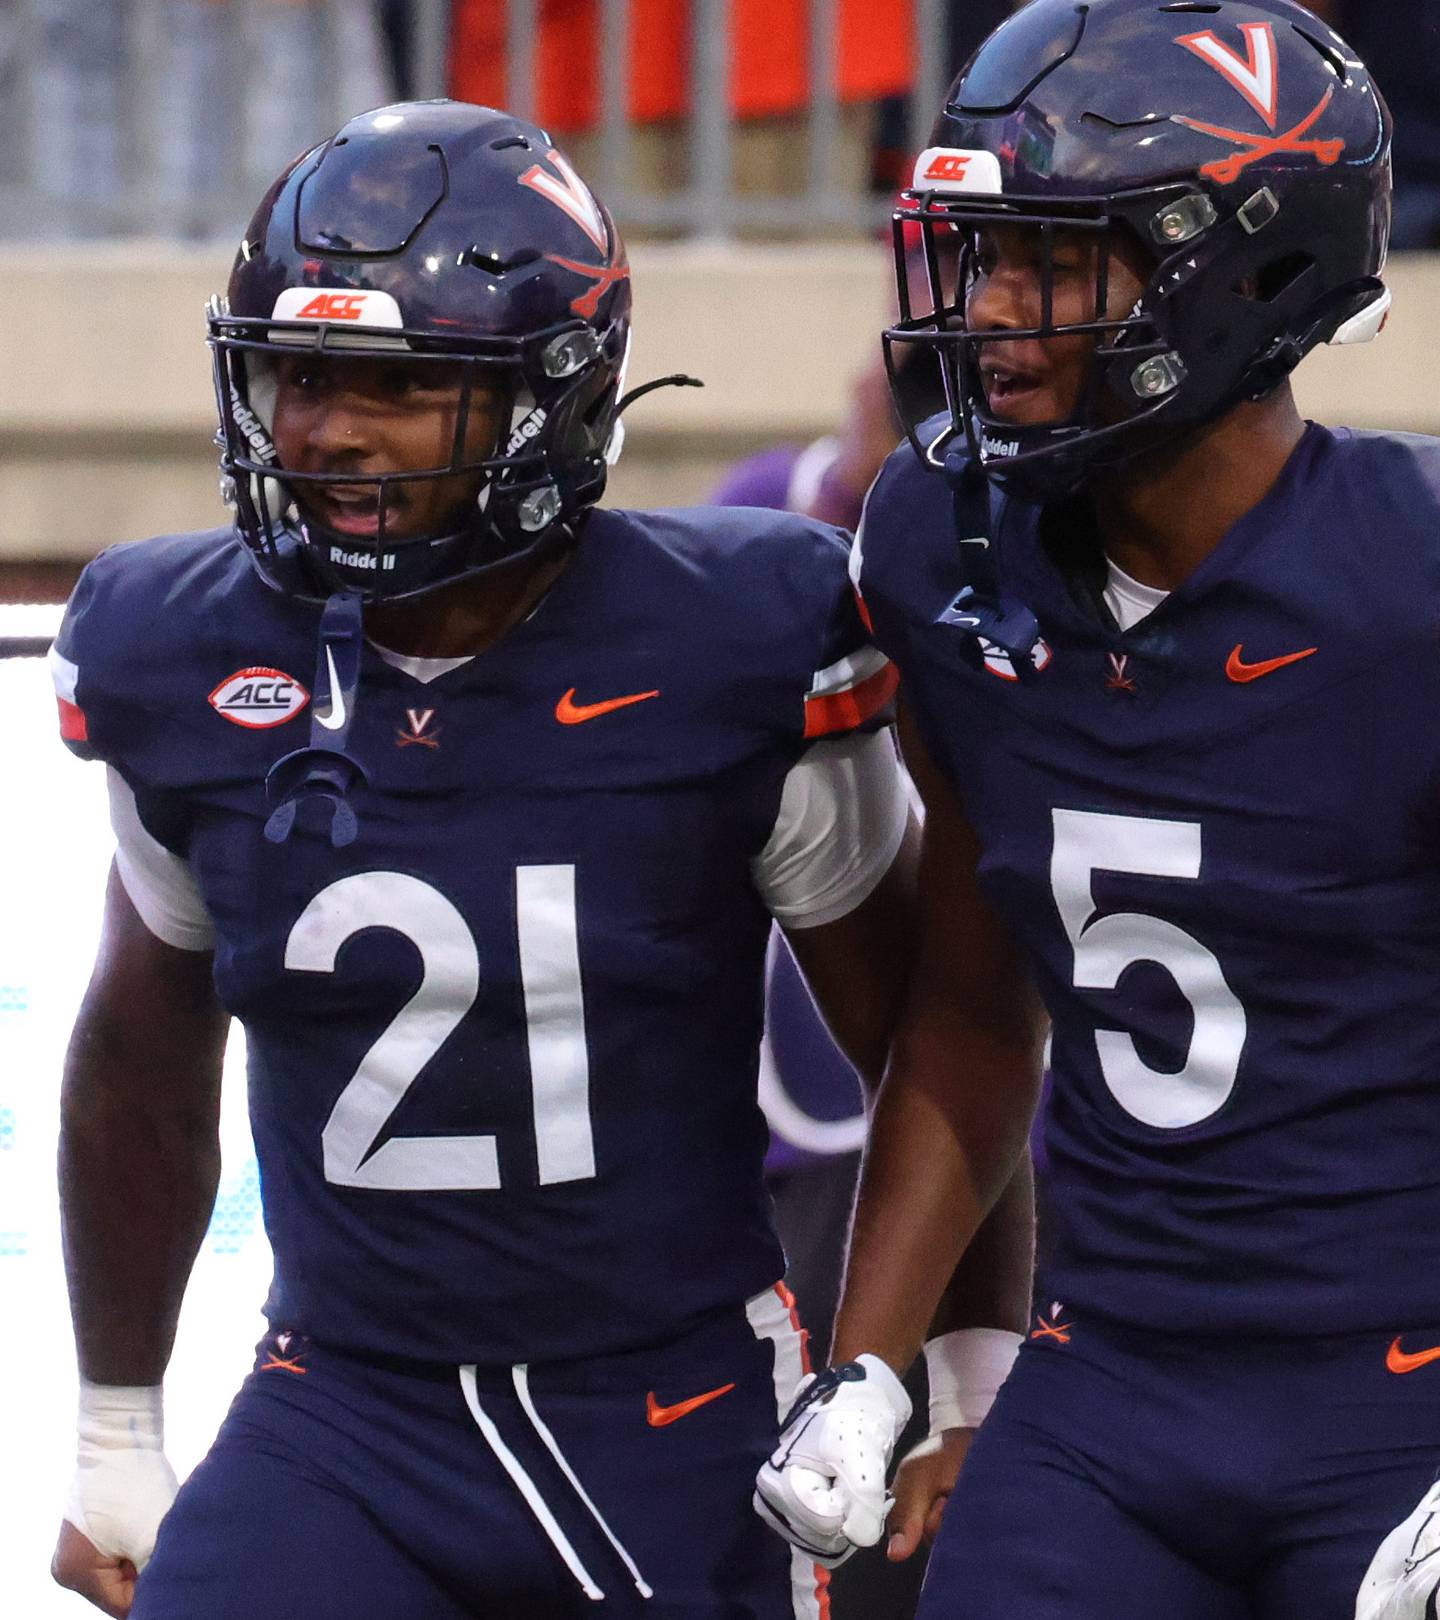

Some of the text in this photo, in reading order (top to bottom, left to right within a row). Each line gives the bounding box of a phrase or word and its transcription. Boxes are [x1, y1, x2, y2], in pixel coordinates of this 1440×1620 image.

[296, 294, 369, 320] ACC
[329, 546, 396, 570] Riddell
[225, 682, 294, 704] ACC
[1050, 807, 1248, 1129] 5
[283, 863, 597, 1190] 21
